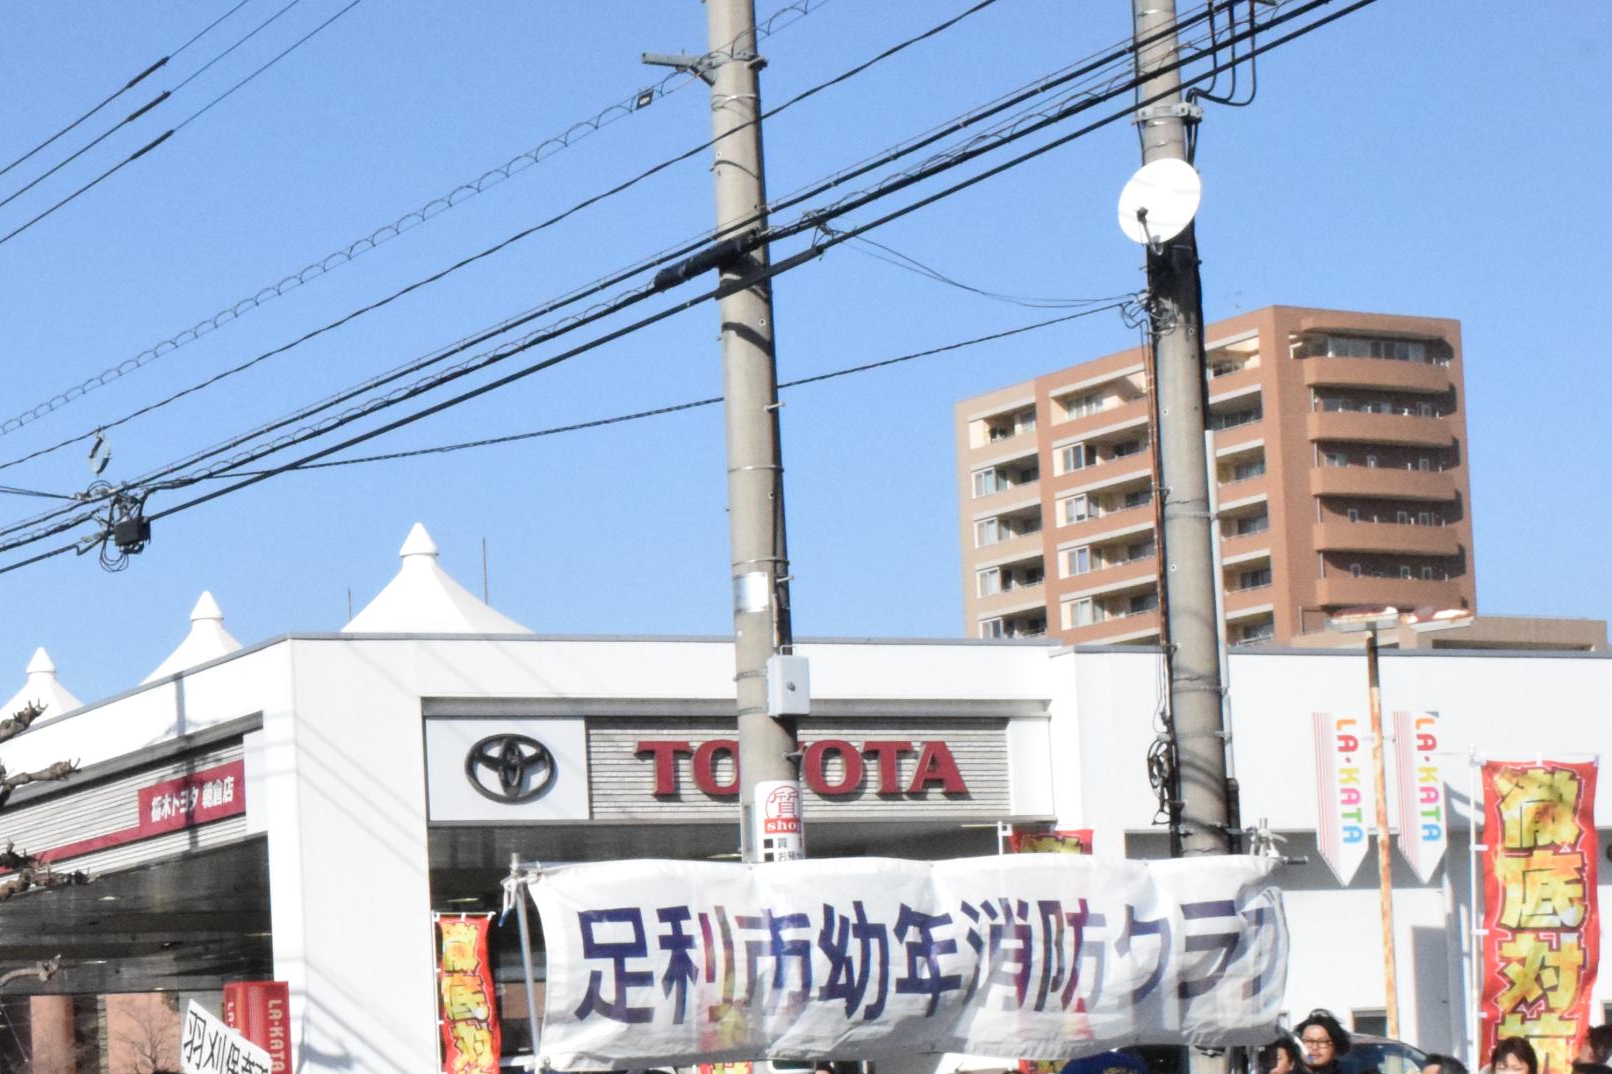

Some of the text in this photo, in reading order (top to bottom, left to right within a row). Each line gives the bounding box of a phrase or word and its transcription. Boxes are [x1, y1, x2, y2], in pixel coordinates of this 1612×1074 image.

[634, 739, 968, 796] TOOTA
[151, 775, 235, 823] 栃木トヨタ 朝倉店
[574, 890, 1280, 1026] 足利市幼年消防クラブ
